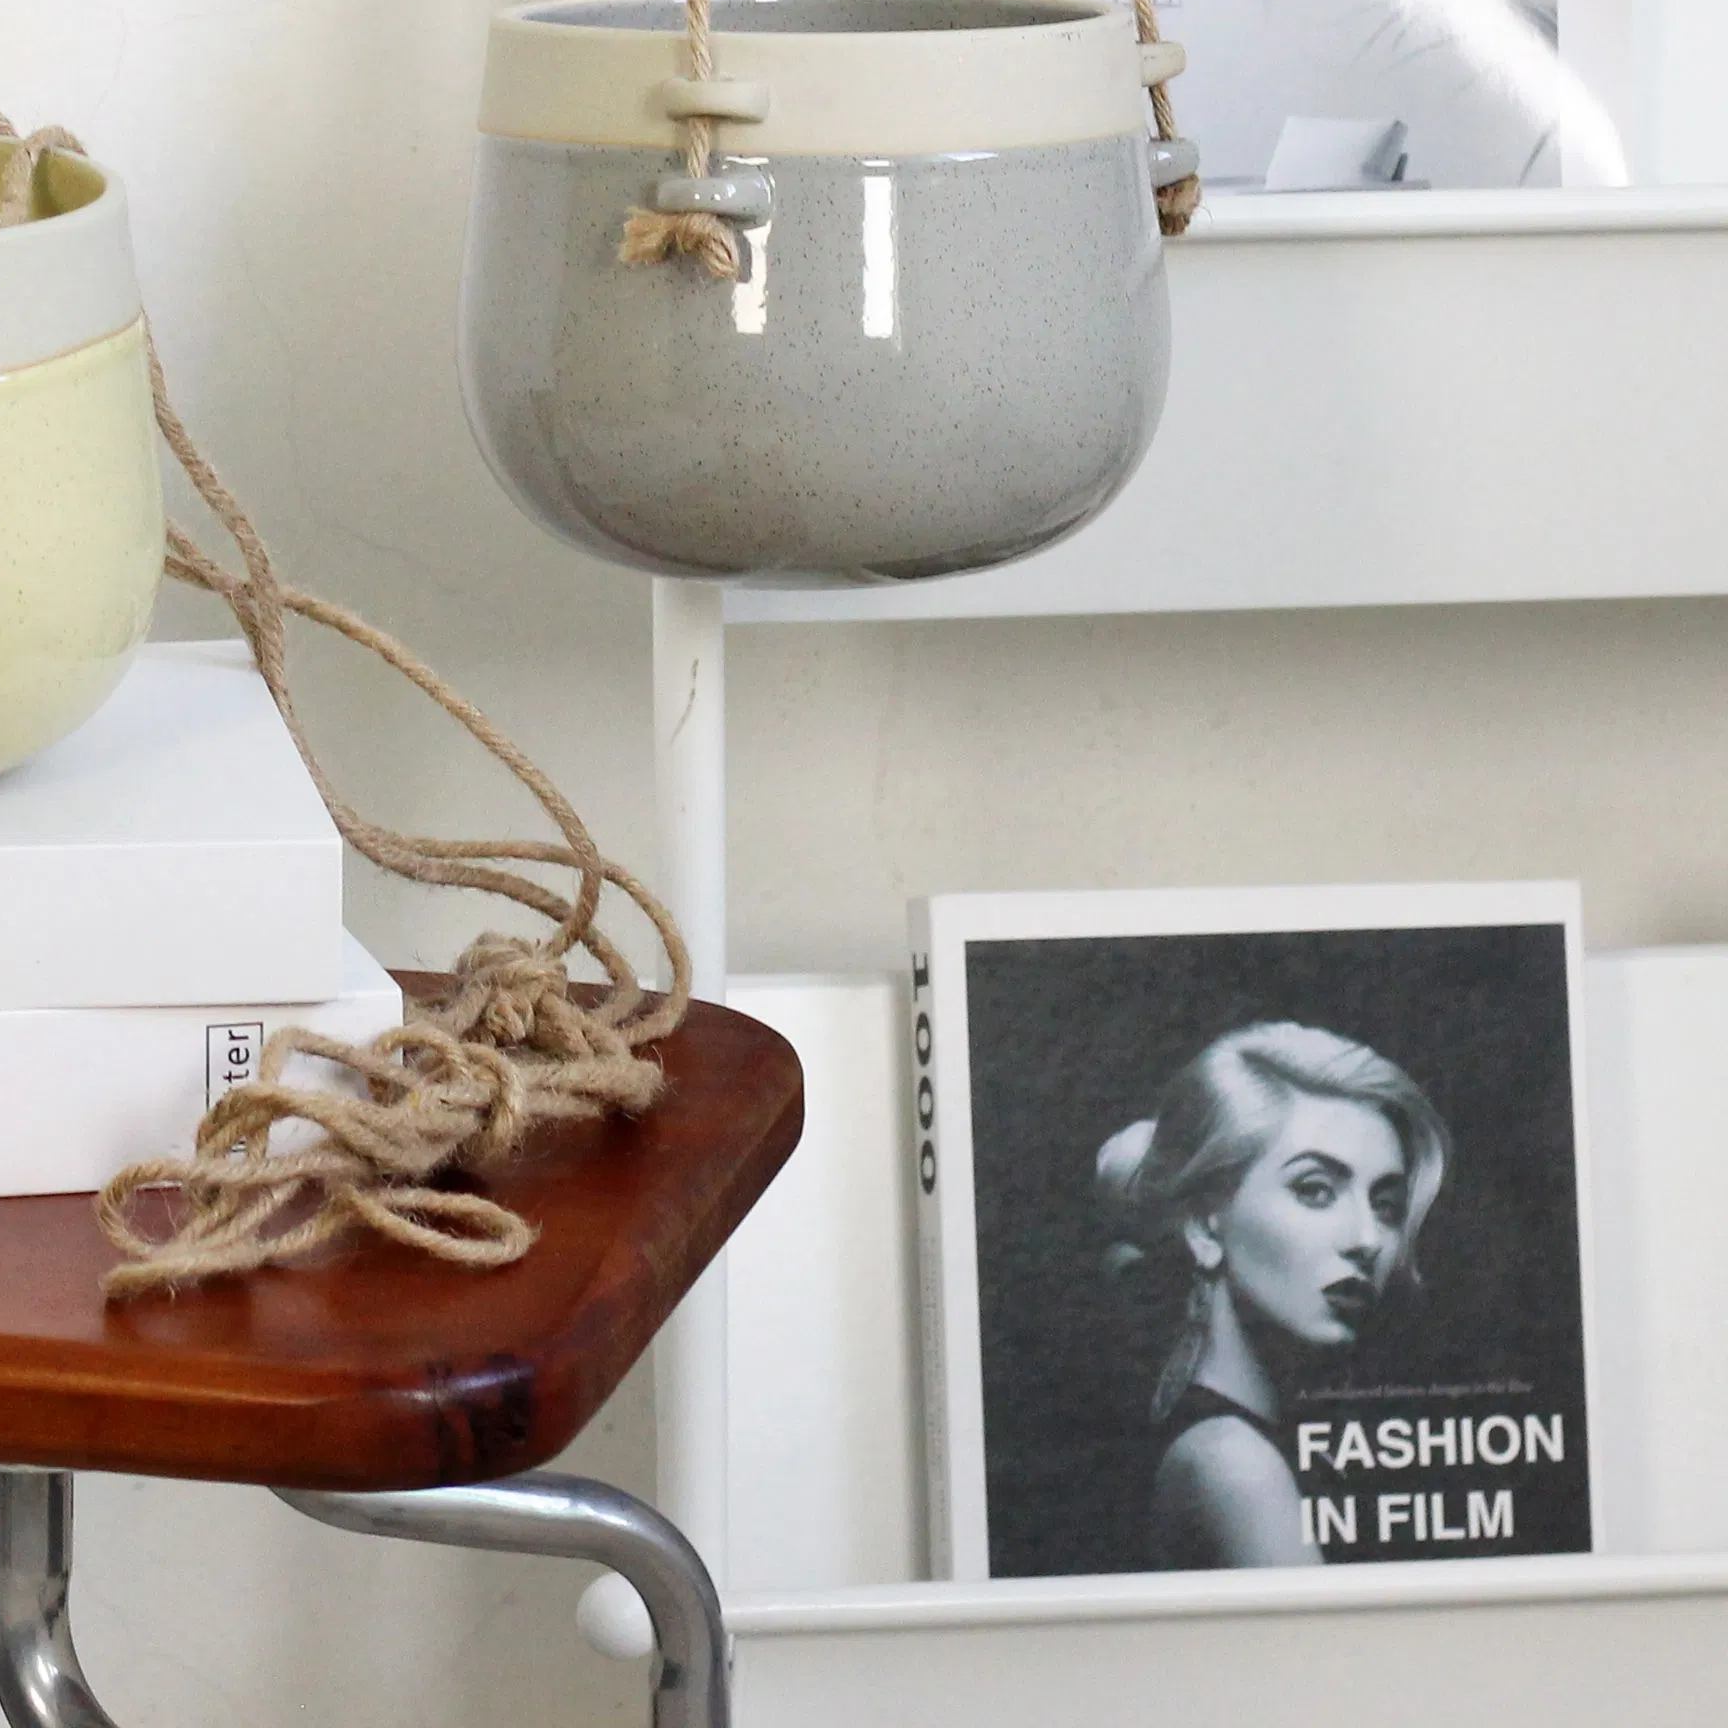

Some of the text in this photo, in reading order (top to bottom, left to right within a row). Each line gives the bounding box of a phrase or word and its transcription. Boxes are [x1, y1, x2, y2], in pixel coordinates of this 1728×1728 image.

[912, 953, 937, 1196] 1000
[1297, 1413, 1565, 1471] FASHION
[1300, 1489, 1514, 1546] IN FILM
